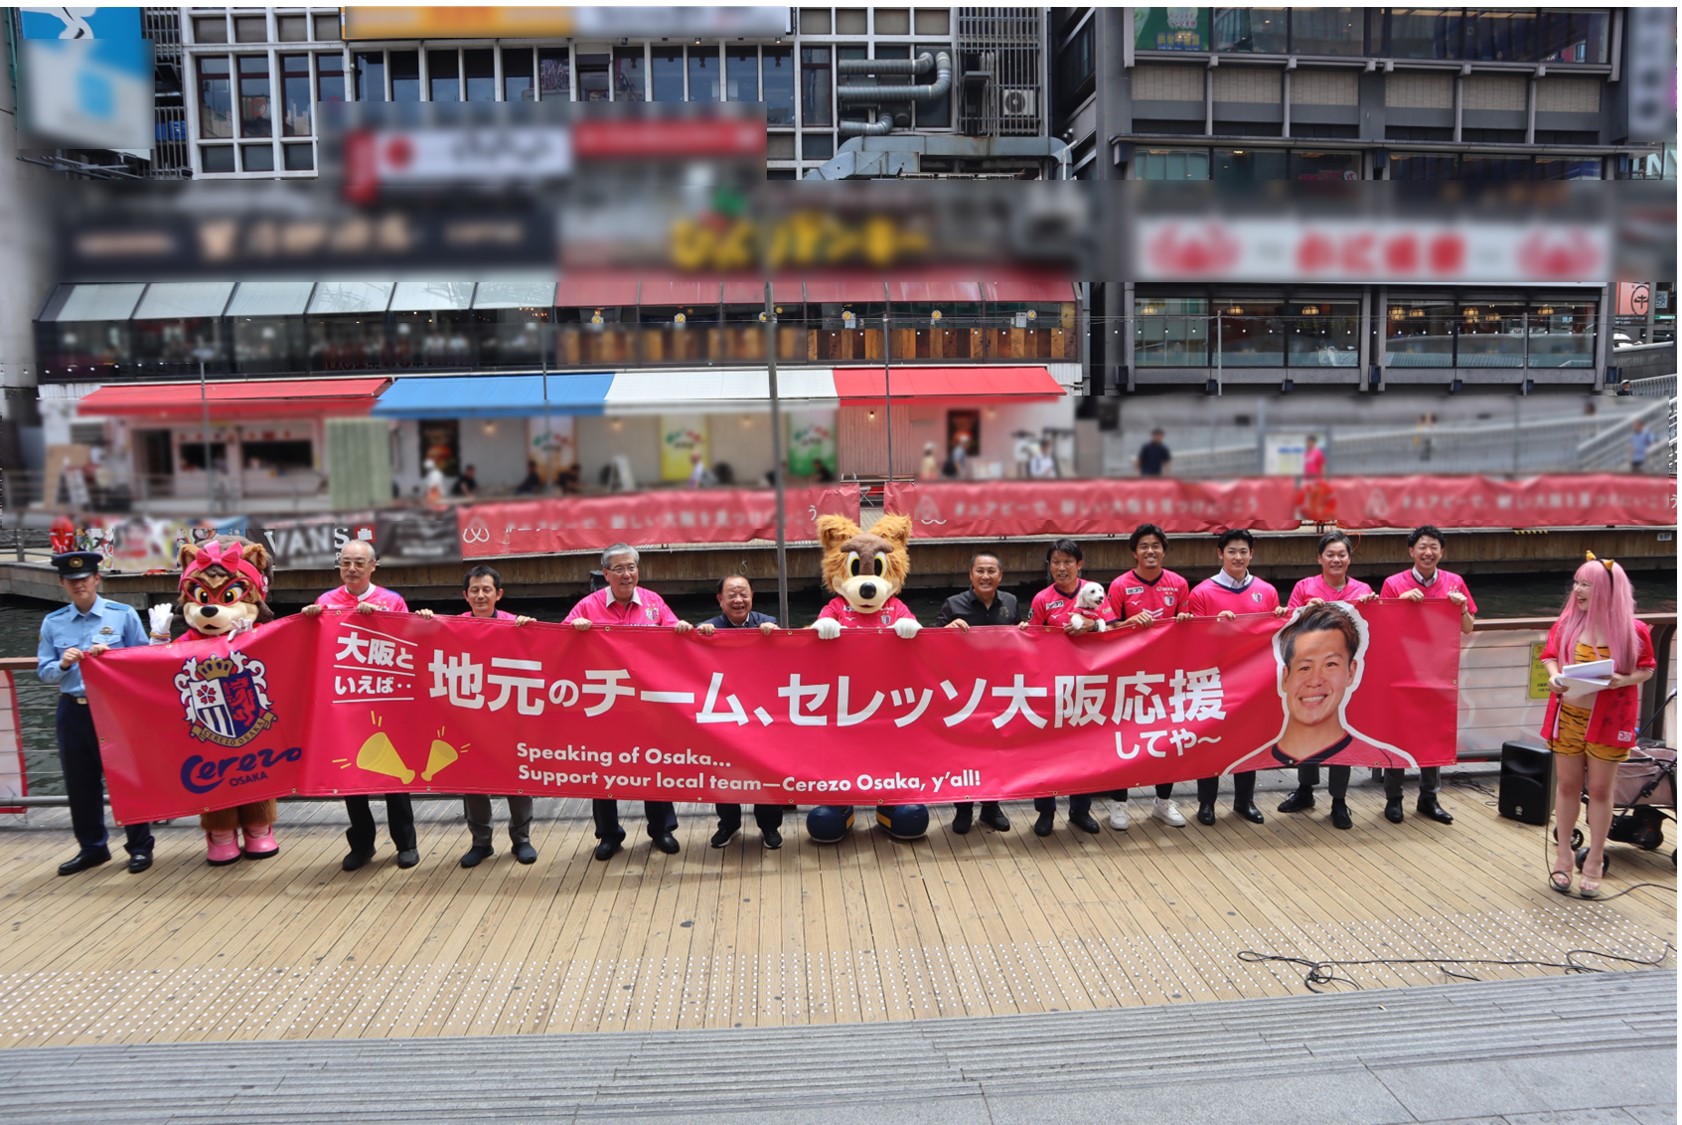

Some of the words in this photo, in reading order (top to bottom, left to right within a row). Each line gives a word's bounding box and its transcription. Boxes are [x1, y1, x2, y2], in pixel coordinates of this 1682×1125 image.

[335, 631, 414, 670] 大阪と
[428, 649, 1227, 729] 地元のチーム、セレッソ大阪応援
[204, 730, 236, 746] CEREZO
[238, 720, 264, 745] OSAKA
[516, 742, 613, 767] Speaking
[618, 746, 640, 764] of
[180, 747, 303, 794] Cerezo
[229, 771, 268, 787] OSAKA
[518, 764, 599, 787] Support
[603, 774, 651, 790] your
[656, 771, 705, 789] local
[856, 771, 926, 792] Osaka,
